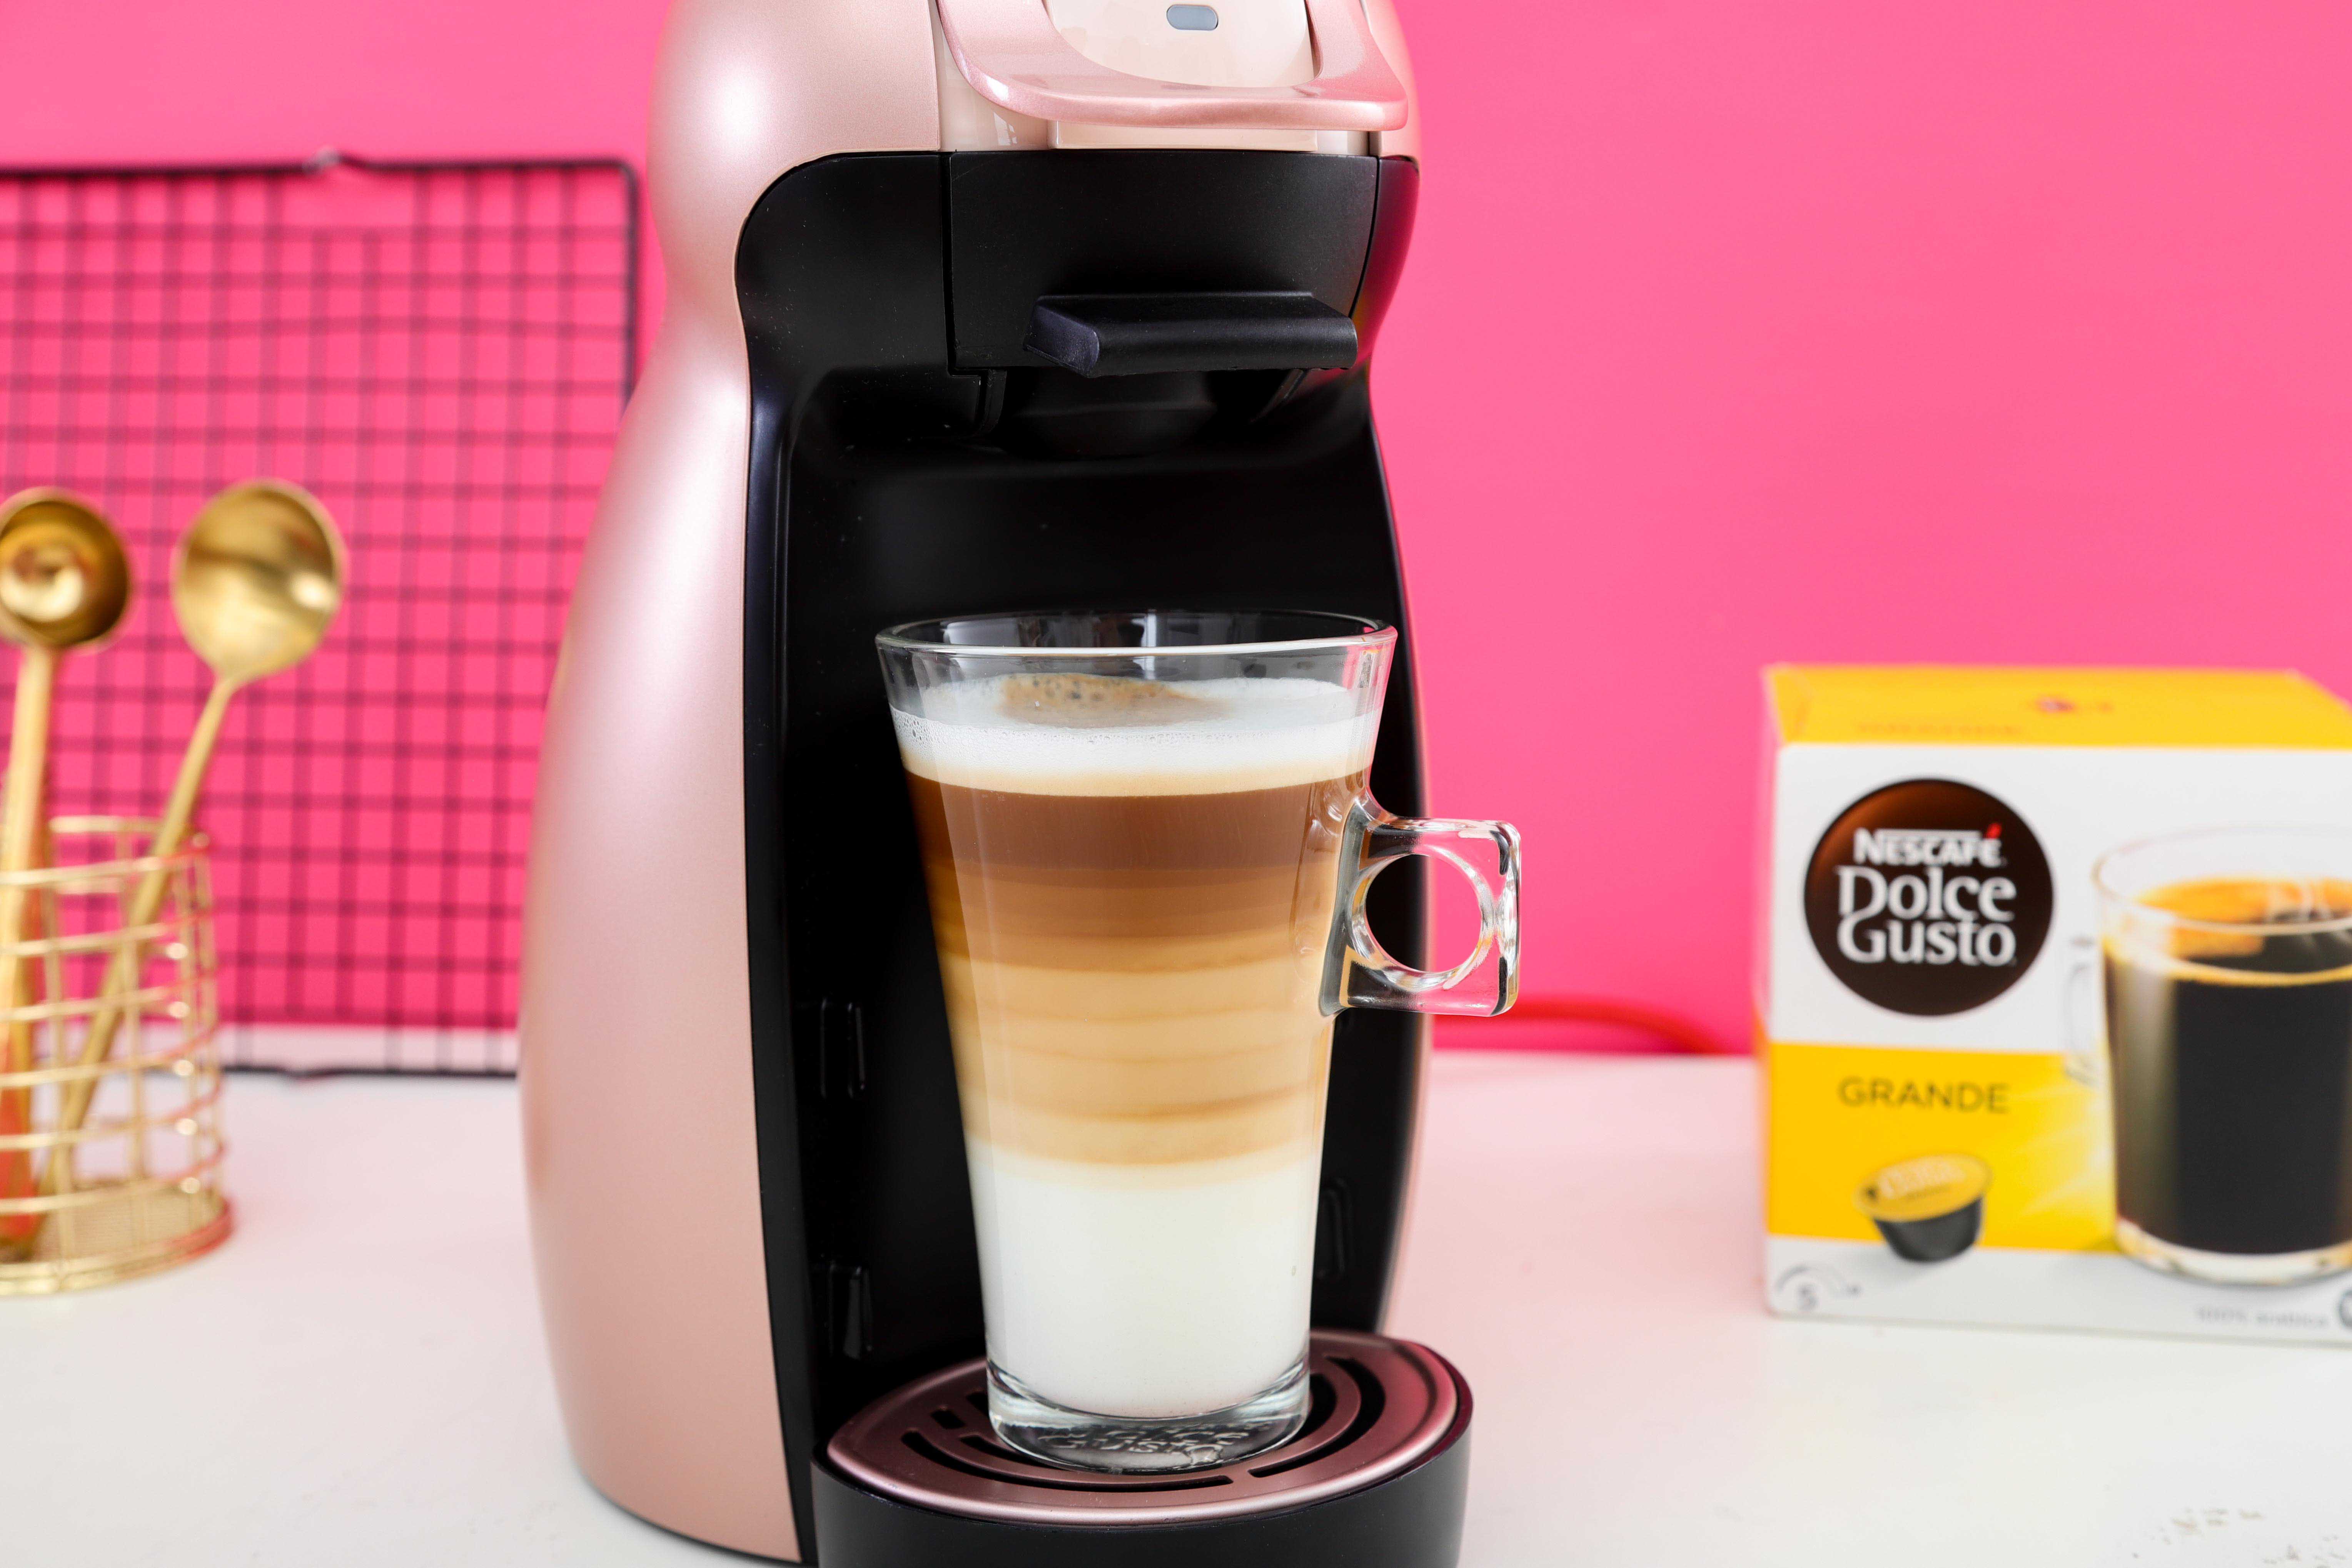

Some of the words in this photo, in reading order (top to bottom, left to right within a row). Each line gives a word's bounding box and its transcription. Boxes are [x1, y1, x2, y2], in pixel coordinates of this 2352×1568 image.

[1835, 865, 2017, 922] Dolce
[1837, 917, 2017, 966] Gusto
[1838, 1076, 2010, 1114] GRANDE
